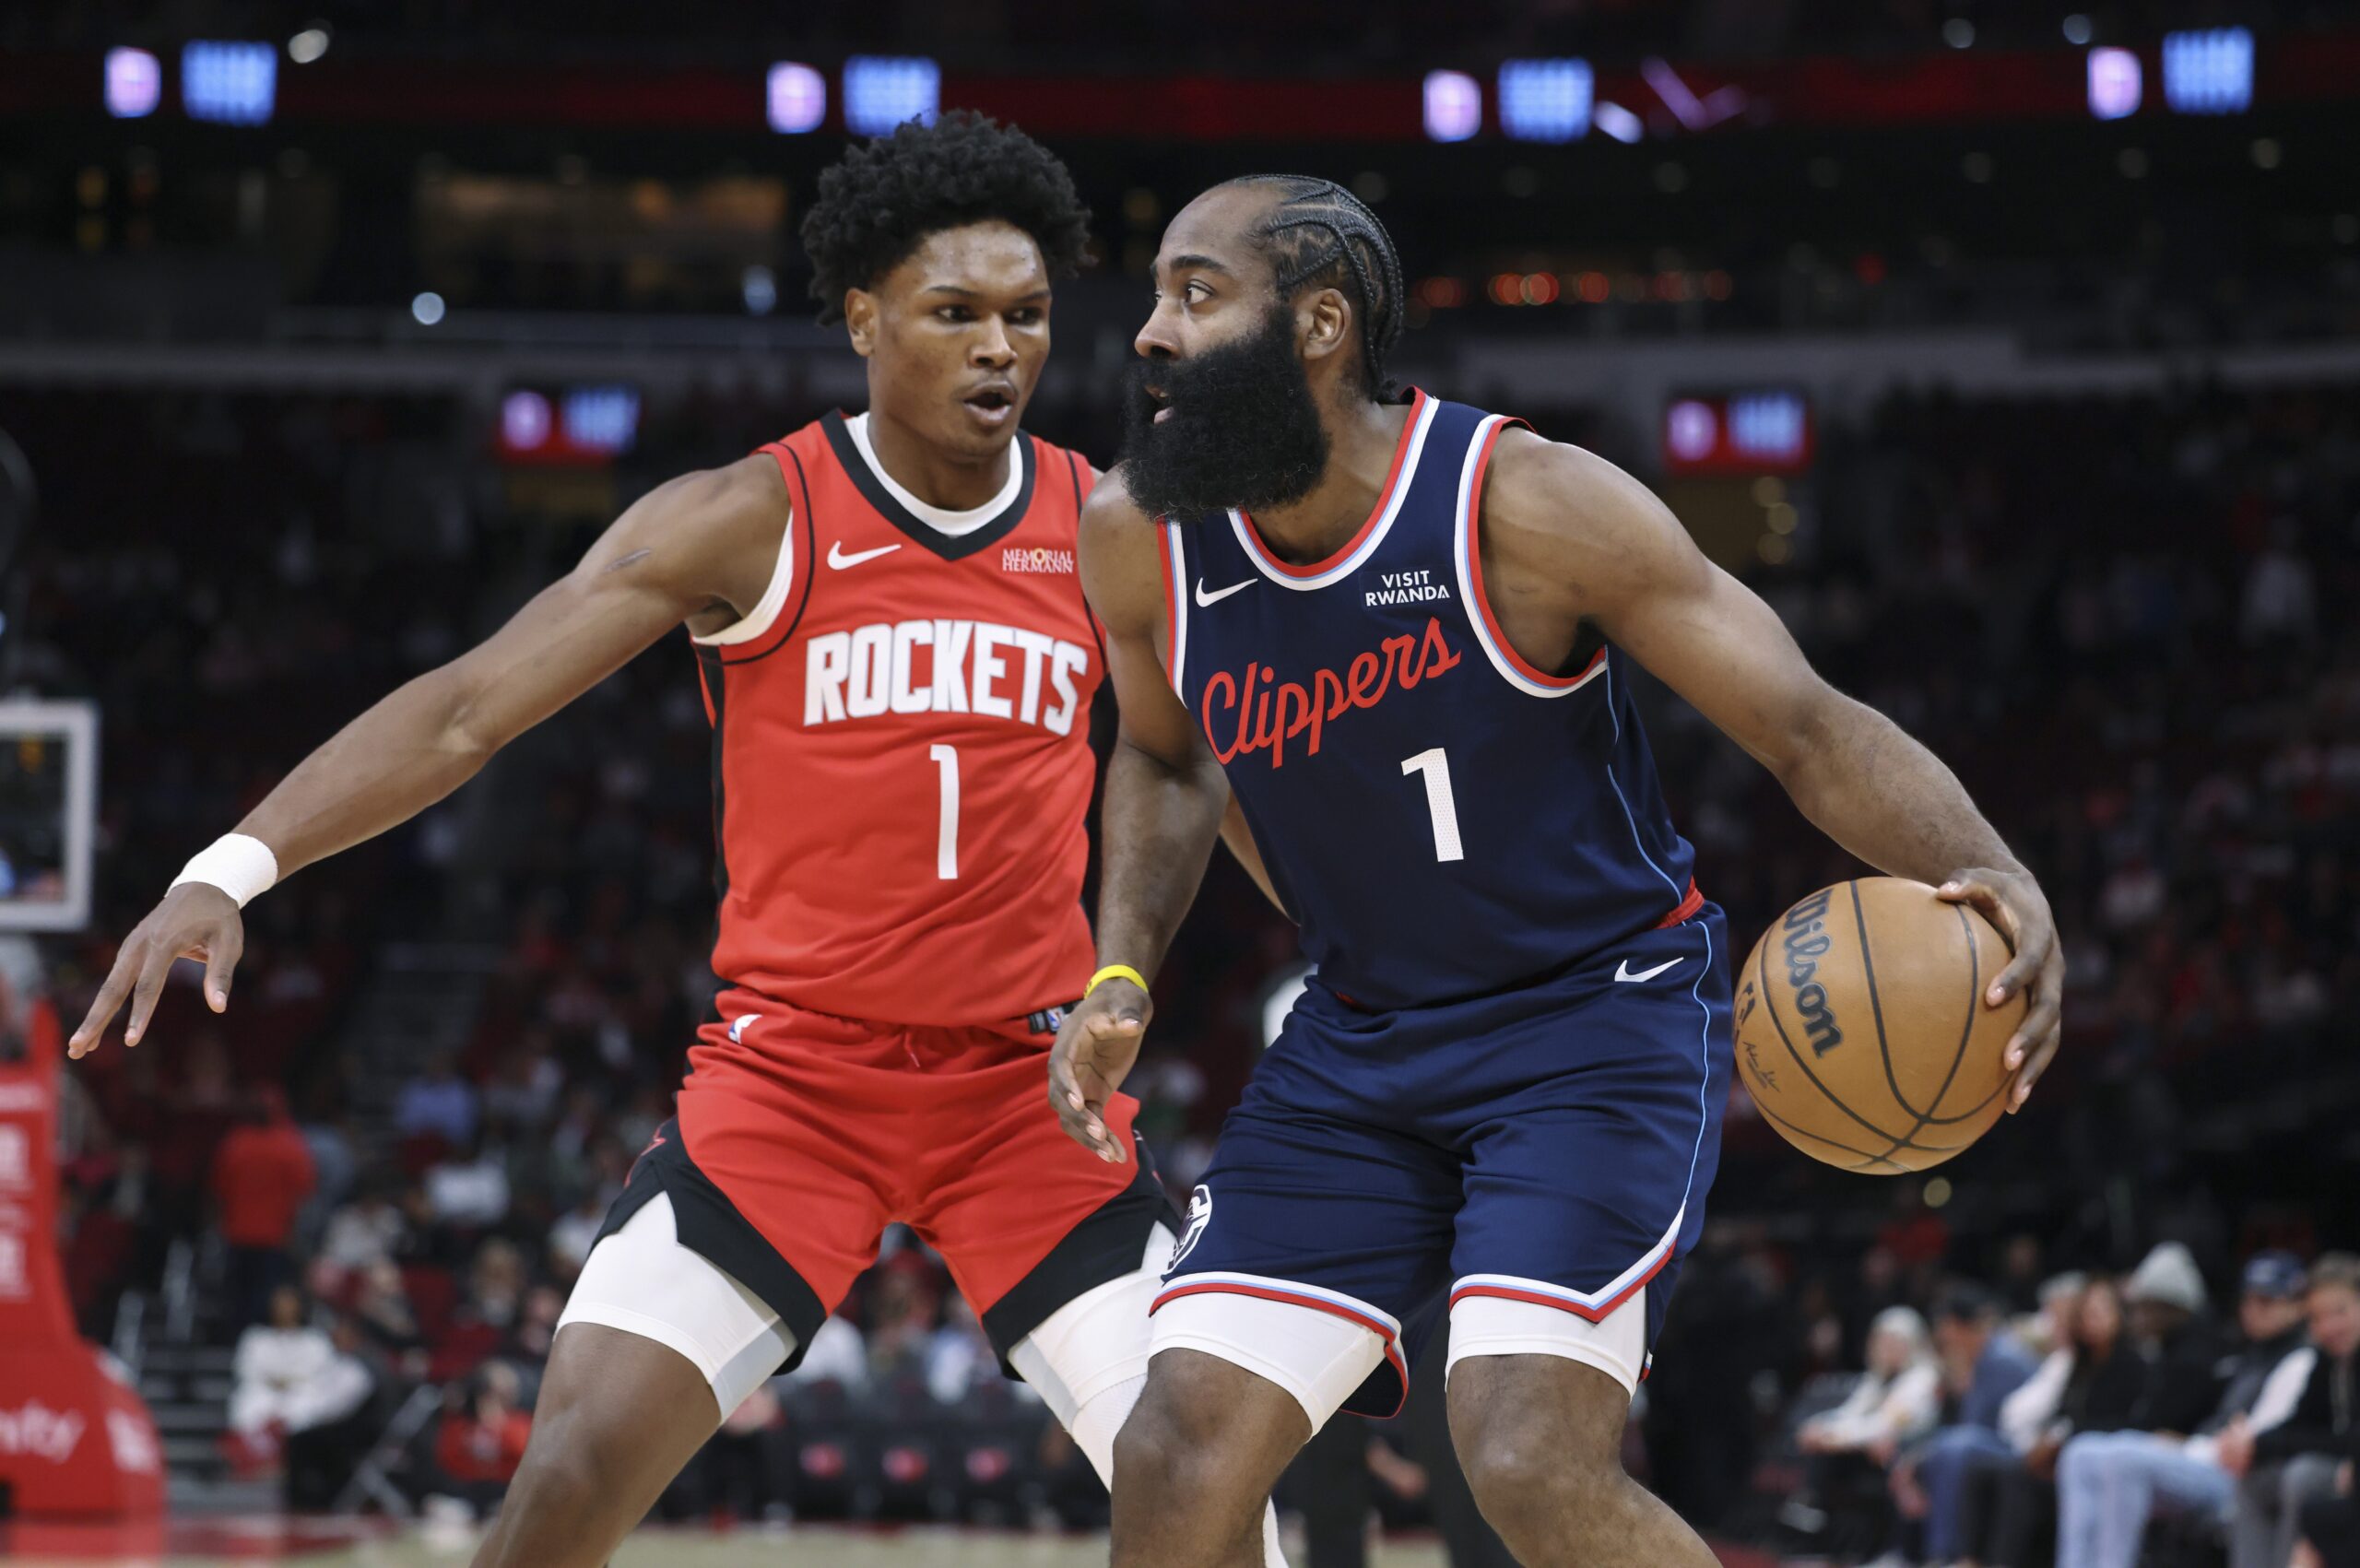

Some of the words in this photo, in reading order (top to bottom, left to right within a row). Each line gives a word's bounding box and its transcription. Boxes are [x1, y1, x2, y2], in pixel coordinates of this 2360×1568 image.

[1002, 548, 1072, 563] MEMORIAL
[1002, 560, 1074, 573] HERMANN
[1365, 584, 1450, 607] RWANDA
[1381, 570, 1430, 588] VISIT
[804, 619, 1088, 737] ROCKETS
[1202, 616, 1461, 770] Clippers
[930, 744, 960, 879] 1
[1400, 748, 1464, 863] 1
[1783, 888, 1842, 1059] Wilson
